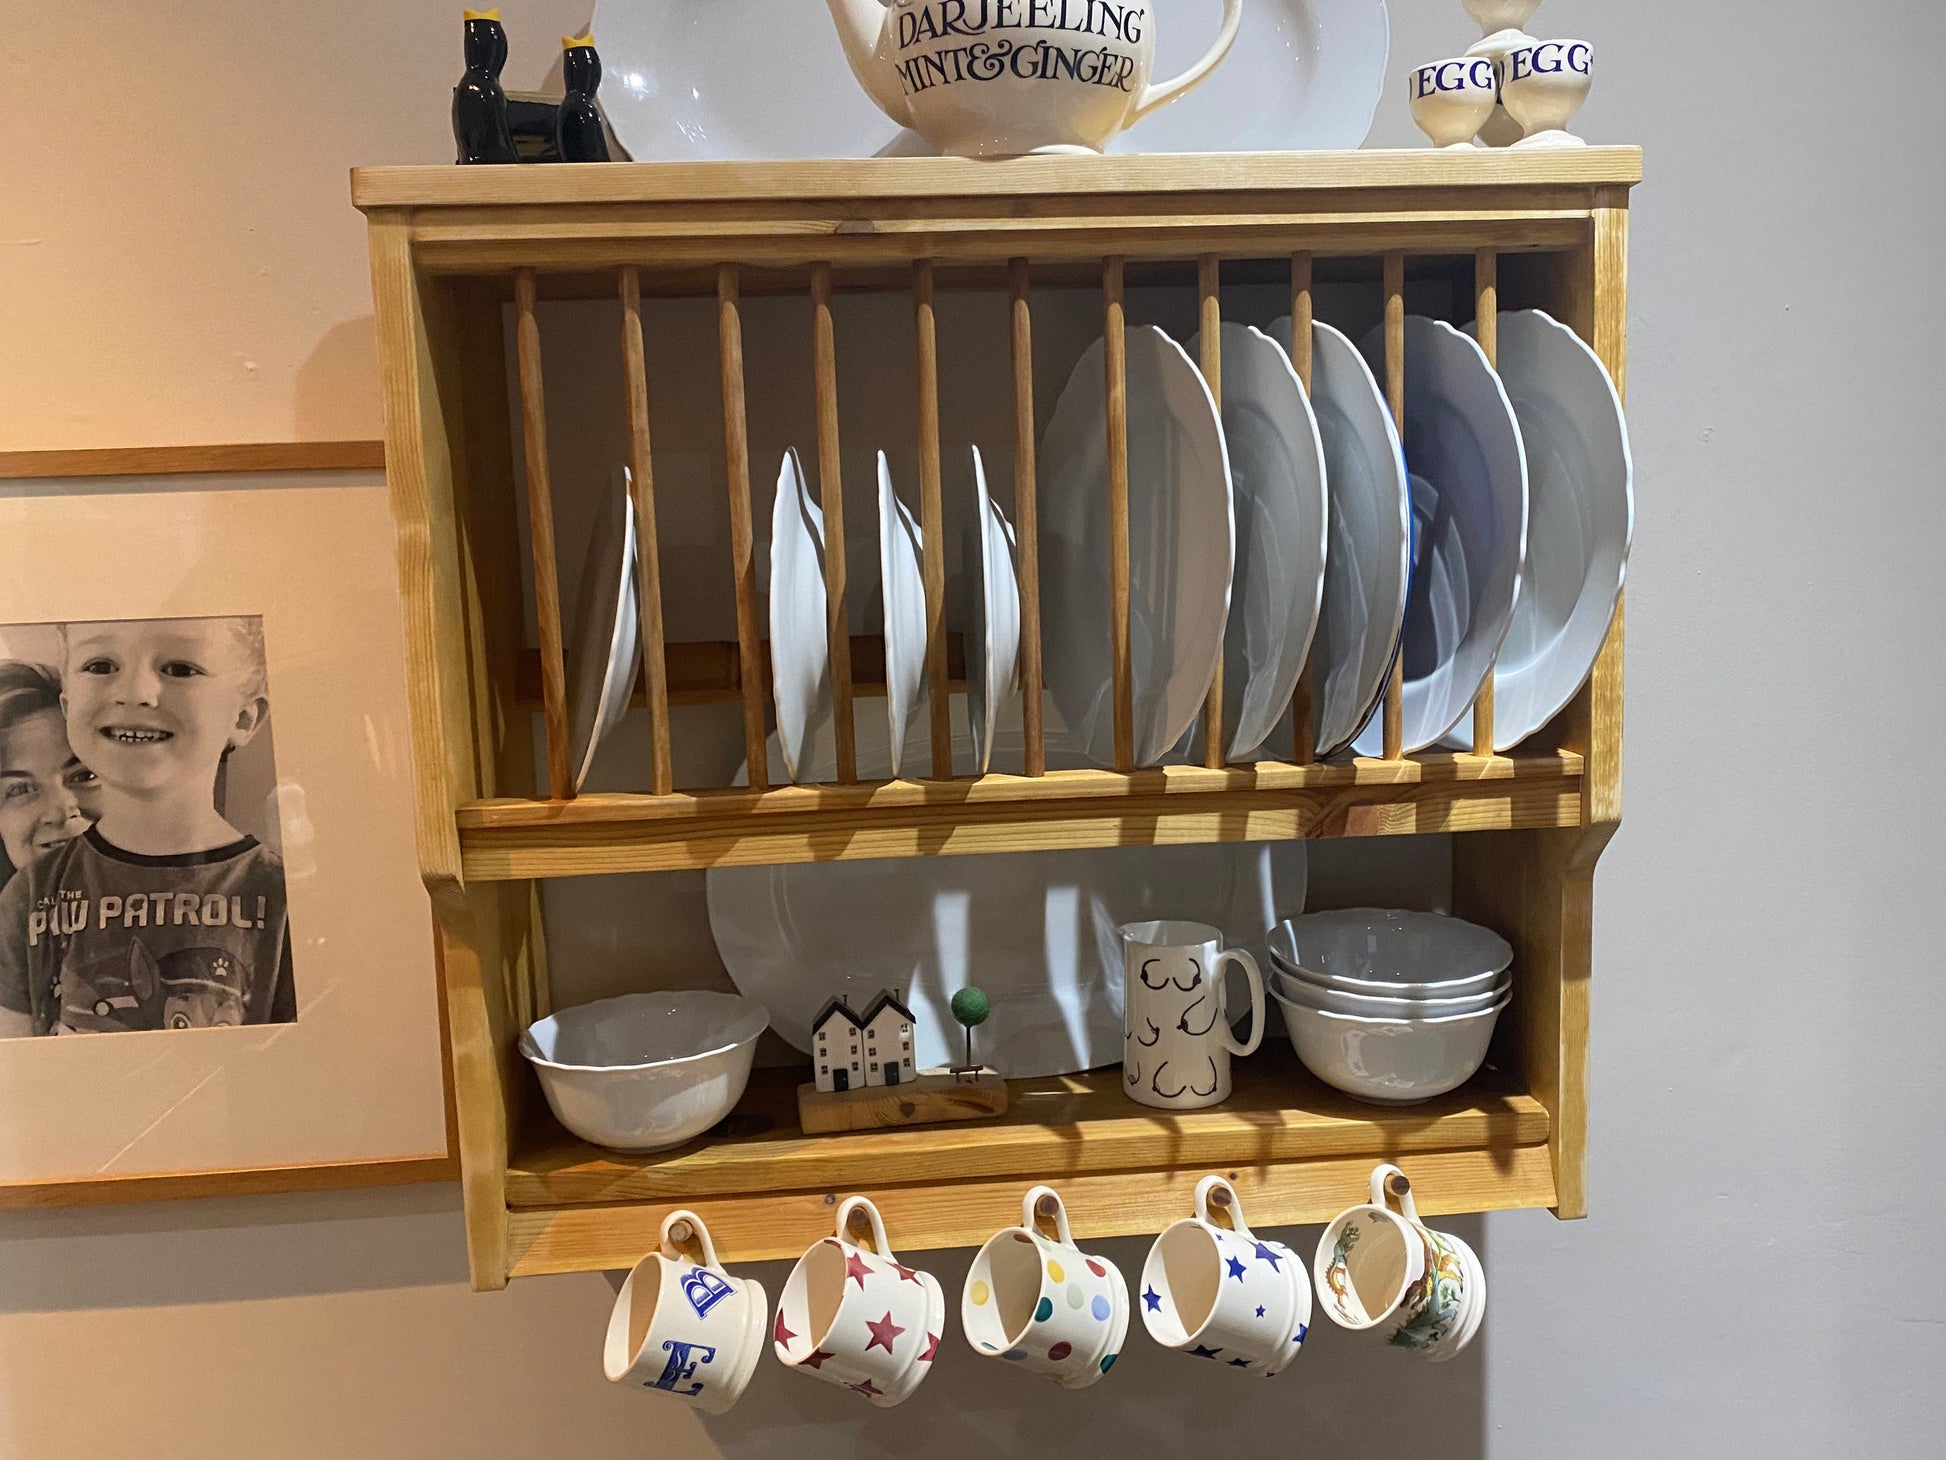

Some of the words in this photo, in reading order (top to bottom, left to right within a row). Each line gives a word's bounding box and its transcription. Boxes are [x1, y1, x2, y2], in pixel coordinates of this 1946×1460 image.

[898, 0, 1145, 50] DARJEELING
[1416, 60, 1493, 100] EGG
[1510, 43, 1590, 83] EGG
[36, 896, 56, 909] CAL
[60, 890, 82, 899] THE
[100, 892, 267, 930] PATROL!
[680, 1266, 738, 1321] B
[643, 1340, 717, 1397] E
